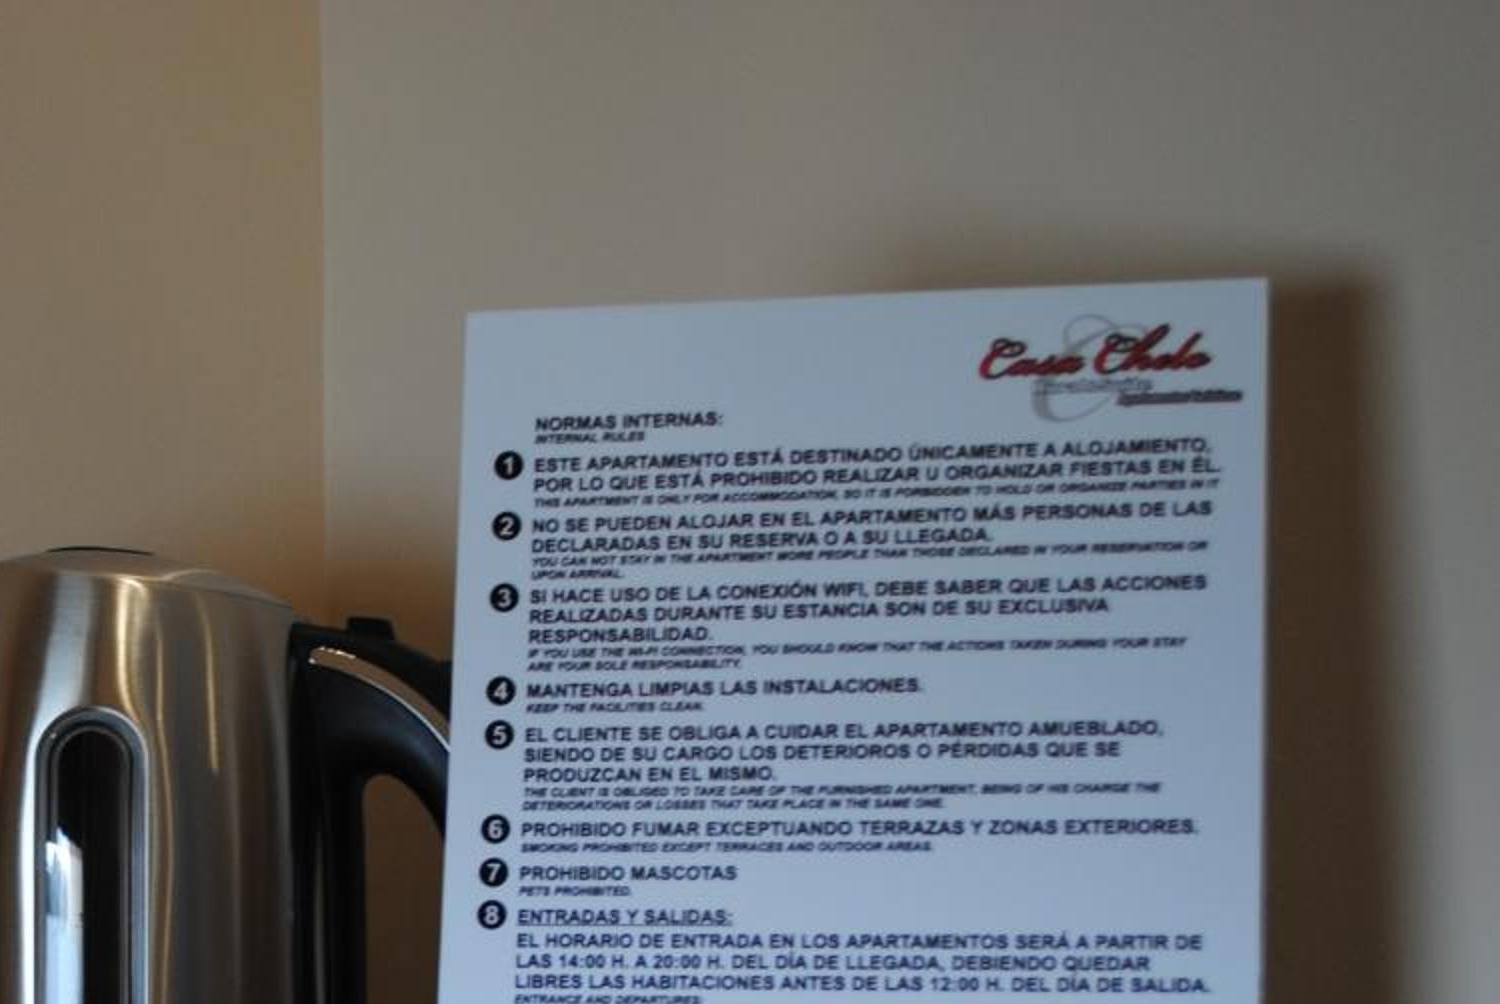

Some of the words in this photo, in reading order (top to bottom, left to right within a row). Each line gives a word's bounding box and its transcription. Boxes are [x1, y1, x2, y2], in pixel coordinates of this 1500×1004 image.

[978, 337, 1088, 381] Casa
[1091, 322, 1213, 377] Chelo
[535, 414, 616, 432] NORMAS
[533, 456, 581, 473] ESTE
[585, 451, 729, 470] APARTAMENTO
[732, 447, 784, 467] ESTÁ
[789, 446, 903, 464] DESTINADO
[907, 442, 1038, 461] ÚNICAMENTE
[1042, 442, 1056, 456] A
[532, 476, 573, 493] POR
[578, 475, 604, 491] LO
[608, 474, 648, 490] QUE
[654, 469, 704, 489] ESTÁ
[709, 468, 818, 487] PROHIBIDO
[822, 466, 919, 483] REALIZAR
[925, 467, 939, 481] U
[944, 461, 1063, 480] ORGANIZAR
[1069, 459, 1152, 476] FIESTAS
[1157, 458, 1185, 474] EN
[531, 517, 560, 533] NO
[564, 516, 589, 533] SE
[594, 514, 672, 532] PUEDEN
[675, 513, 754, 529] ALOJAR
[758, 511, 785, 527] EN
[790, 511, 815, 526] EL
[819, 506, 967, 525] APARTAMENTO
[972, 503, 1016, 521] MÁS
[1021, 502, 1133, 520] PERSONAS
[1138, 501, 1165, 517] DE
[1171, 500, 1212, 516] LAS
[531, 535, 660, 553] DECLARADAS
[666, 534, 692, 550] EN
[697, 533, 723, 549] SU
[728, 531, 819, 548] RESERVA
[823, 530, 839, 546] O
[842, 530, 857, 545] A
[862, 529, 888, 544] SU
[525, 681, 633, 698] MANTENGA
[637, 680, 714, 697] LIMPIAS
[719, 679, 757, 696] LAS
[524, 726, 548, 742] EL
[551, 725, 632, 743] CLIENTE
[637, 725, 662, 741] SE
[667, 724, 742, 741] OBLIGA
[744, 724, 759, 739] A
[763, 723, 838, 739] CUIDAR
[844, 722, 868, 739] EL
[872, 721, 1023, 738] APARTAMENTO
[523, 767, 641, 783] PRODUZCAN
[646, 766, 673, 782] EN
[678, 766, 702, 782] EL
[520, 821, 627, 837] PROHIBIDO
[631, 821, 700, 837] FUMAR
[705, 820, 853, 836] EXCEPTUANDO
[857, 819, 965, 835] TERRAZAS
[970, 819, 983, 834] Y
[987, 818, 1058, 835] ZONAS
[518, 865, 626, 881] PROHIBIDO
[629, 865, 737, 880] MASCOTAS
[516, 908, 621, 923] ENTRADAS
[625, 909, 639, 923] Y
[514, 973, 583, 989] LIBRES
[587, 973, 625, 989] LAS
[630, 974, 775, 990] HABITACIONES
[779, 975, 845, 991] ANTES
[851, 975, 877, 991] DE
[884, 975, 923, 991] LAS
[930, 976, 979, 992] 12:00
[1011, 976, 1050, 992] DEL
[1056, 974, 1090, 992] DÍA
[1096, 976, 1124, 992] DE
